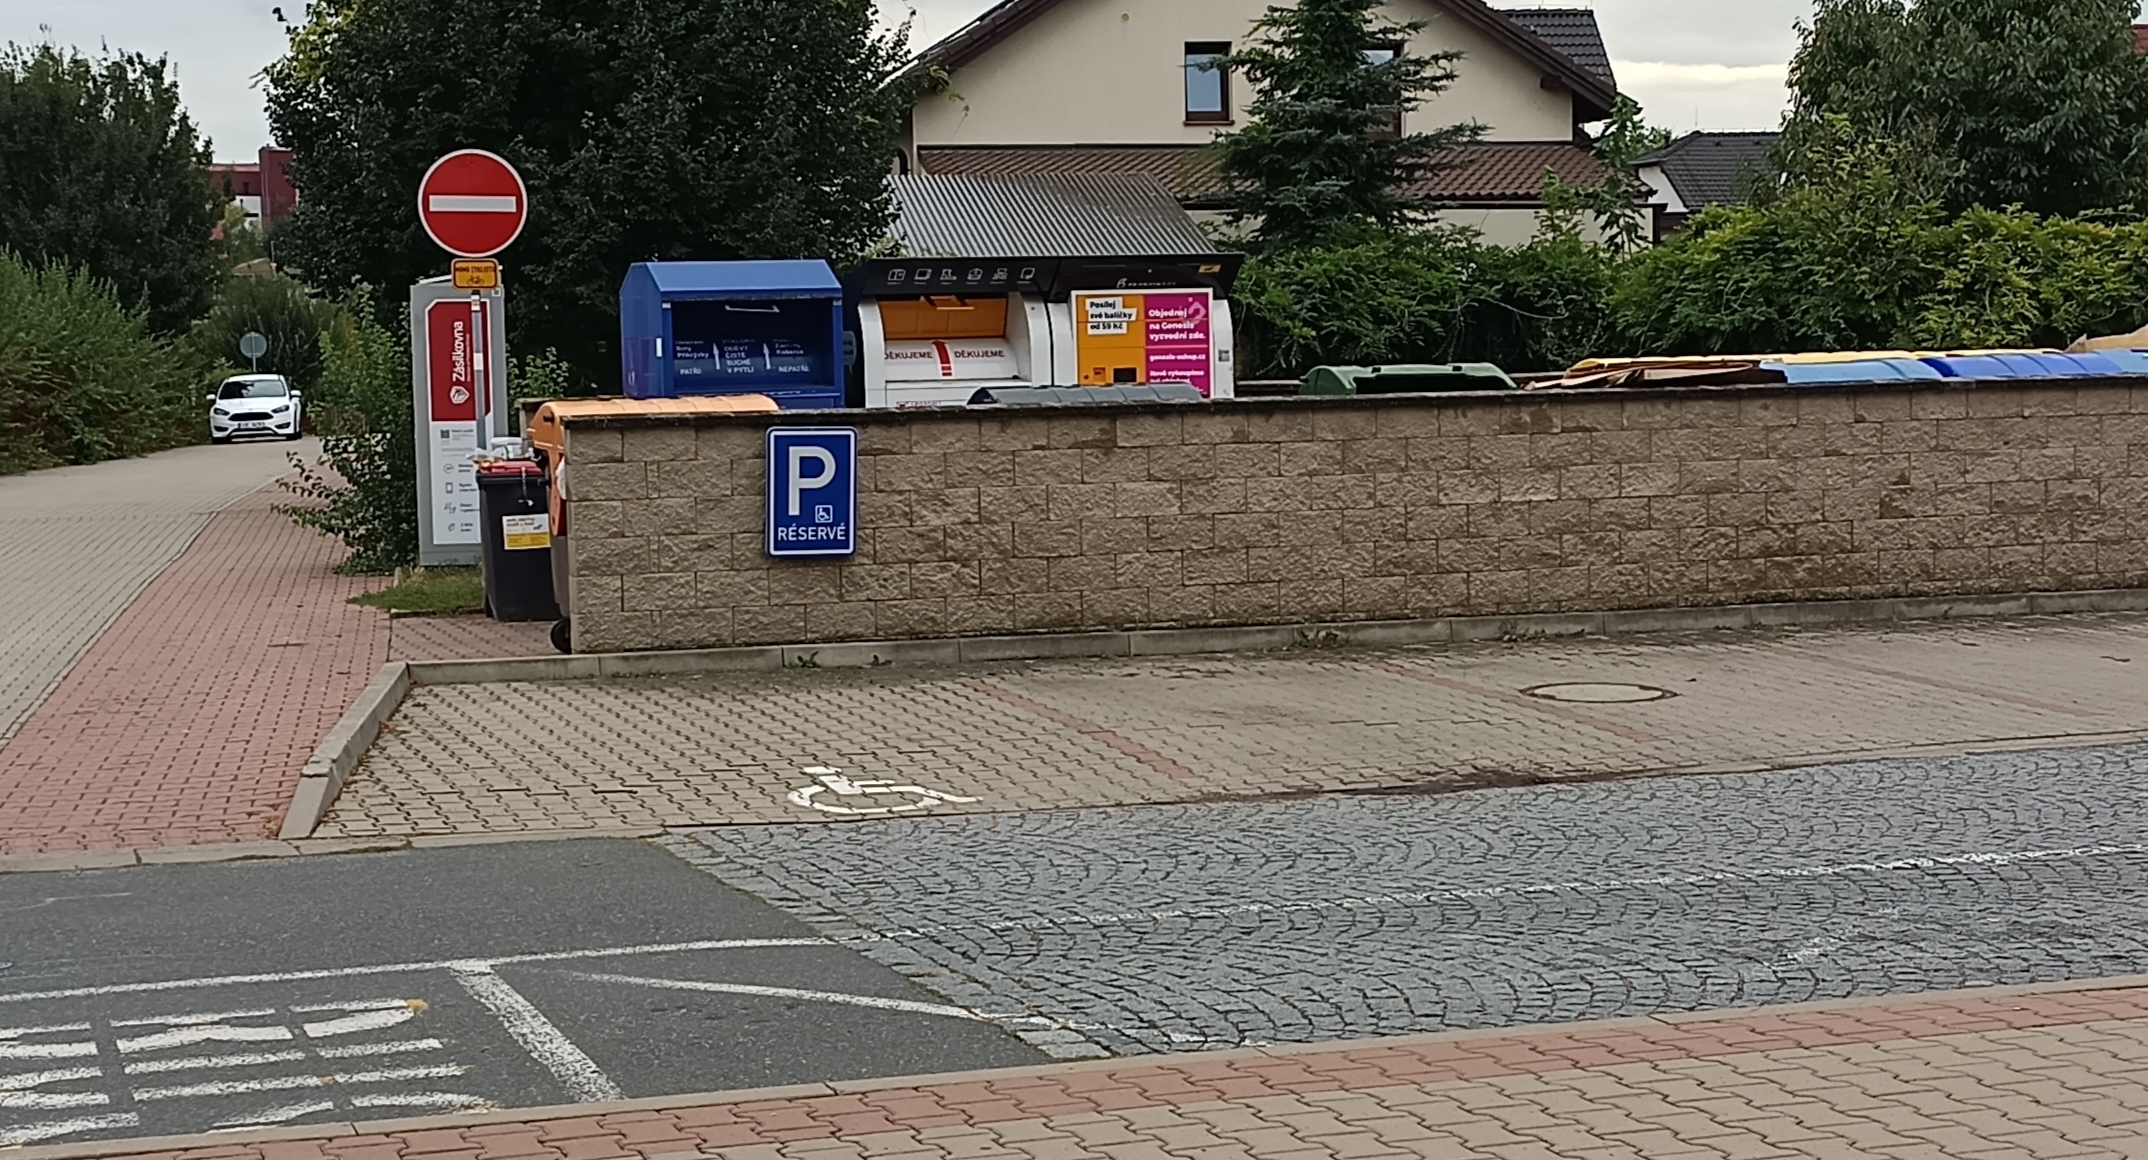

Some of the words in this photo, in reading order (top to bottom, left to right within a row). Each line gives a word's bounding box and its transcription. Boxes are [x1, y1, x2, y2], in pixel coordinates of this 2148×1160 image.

[1090, 300, 1116, 310] Posílej
[1090, 311, 1103, 319] své
[1104, 311, 1133, 320] balíčky
[1090, 322, 1100, 330] od
[1149, 322, 1160, 330] na
[1161, 321, 1195, 330] Genesis
[1149, 331, 1187, 342] vyzvedni
[1188, 331, 1207, 340] zde.
[451, 320, 466, 383] Zásilkovna
[954, 349, 1005, 359] DĚKUJEME
[788, 446, 836, 516] P
[778, 523, 846, 541] RÉSERVÉ
